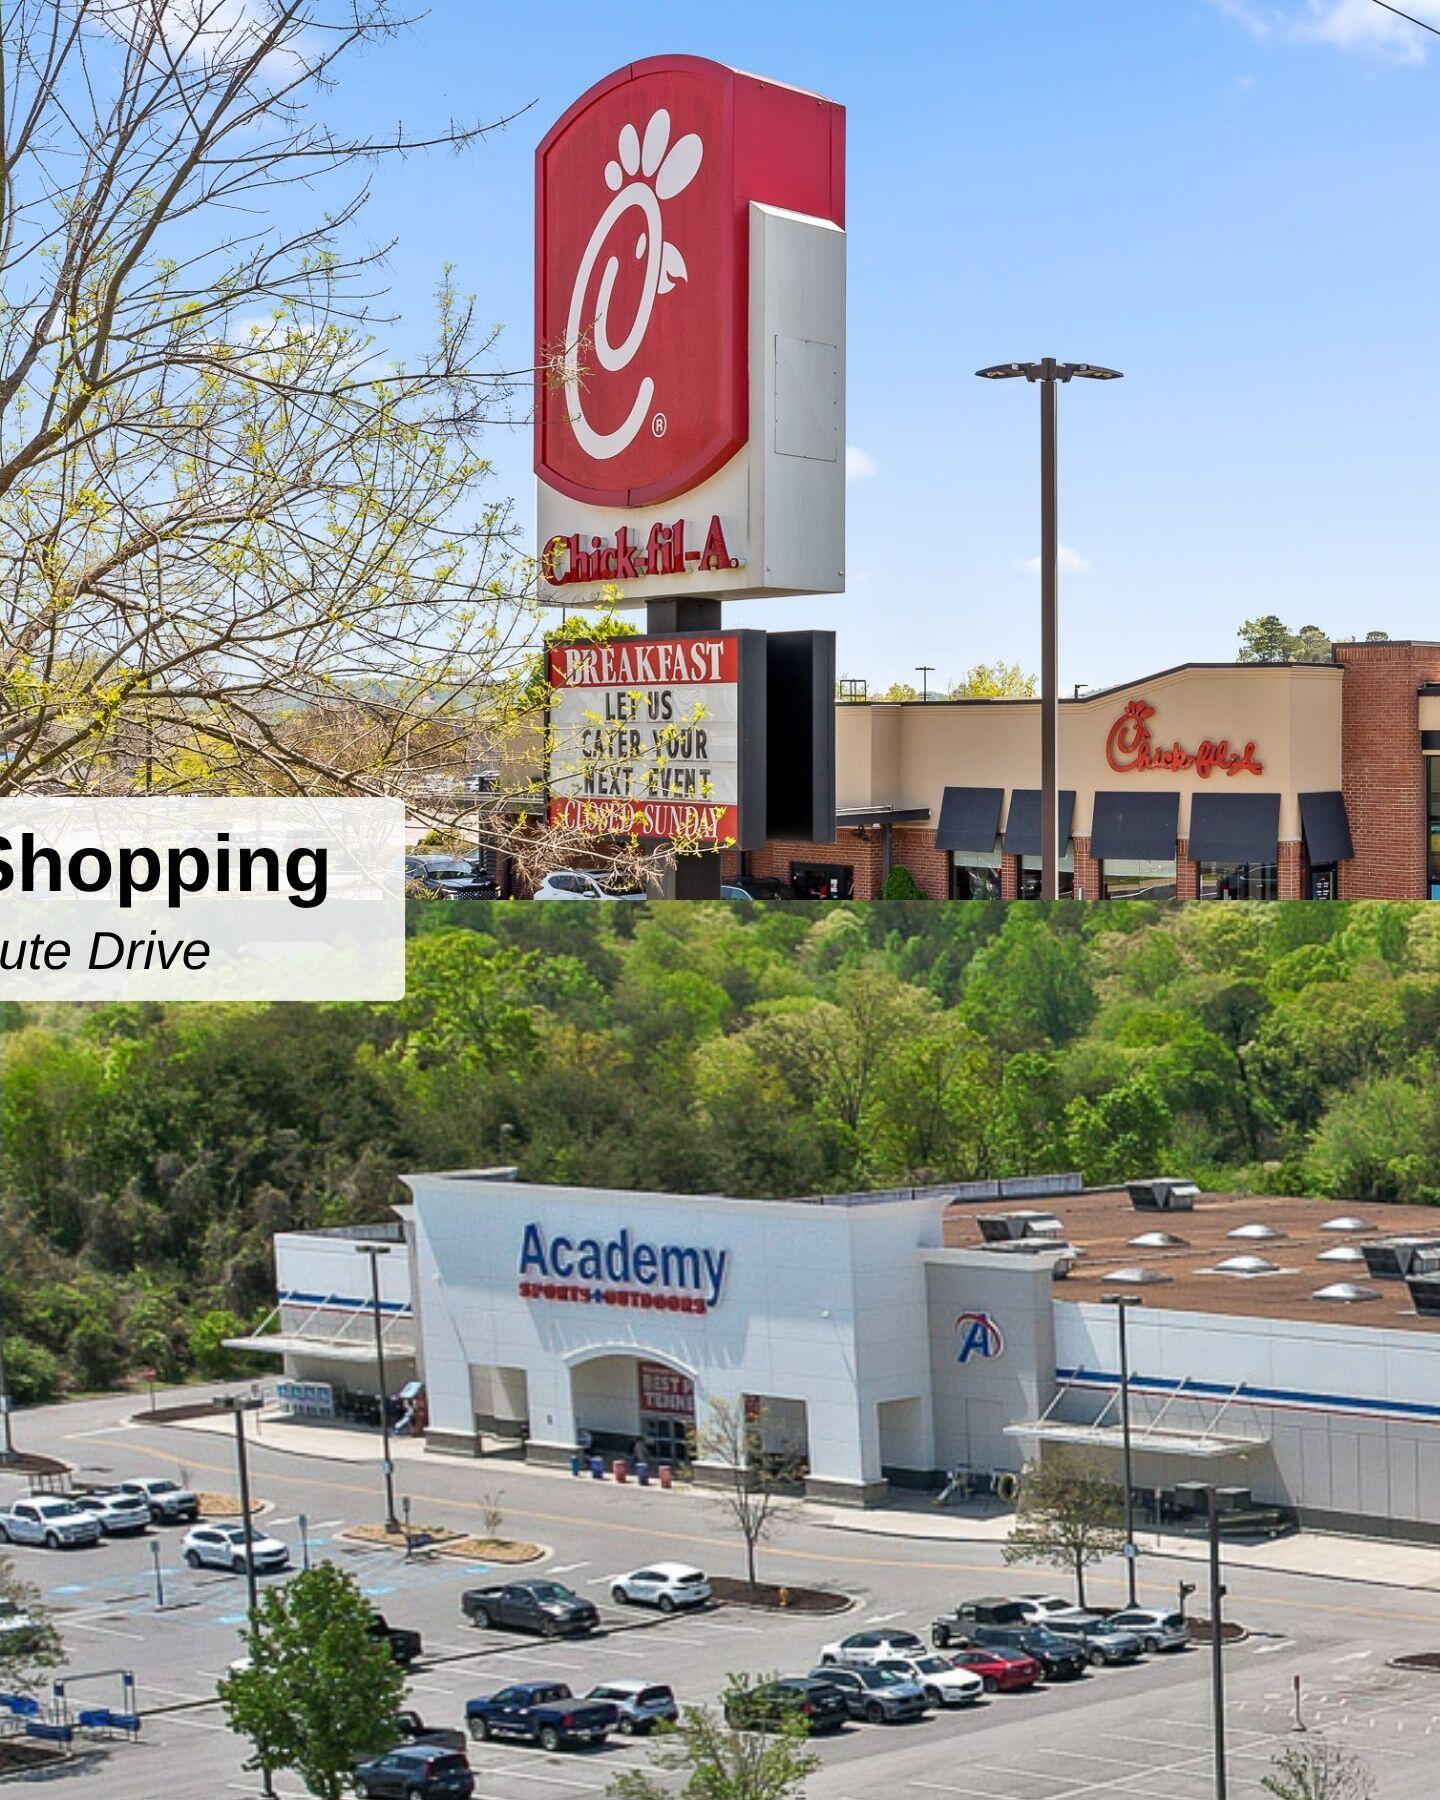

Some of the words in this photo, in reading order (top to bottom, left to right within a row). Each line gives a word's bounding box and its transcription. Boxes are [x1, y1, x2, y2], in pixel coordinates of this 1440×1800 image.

[564, 641, 724, 686] BREAKFAST
[605, 692, 636, 720] LET
[648, 690, 672, 720] US
[582, 729, 640, 758] CATER
[653, 729, 707, 759] YOUR
[584, 765, 633, 796] NEXT
[648, 767, 710, 798] EVENT
[564, 799, 635, 832] CLOSED
[643, 803, 725, 838] SUNDAY
[520, 1223, 726, 1307] Academy
